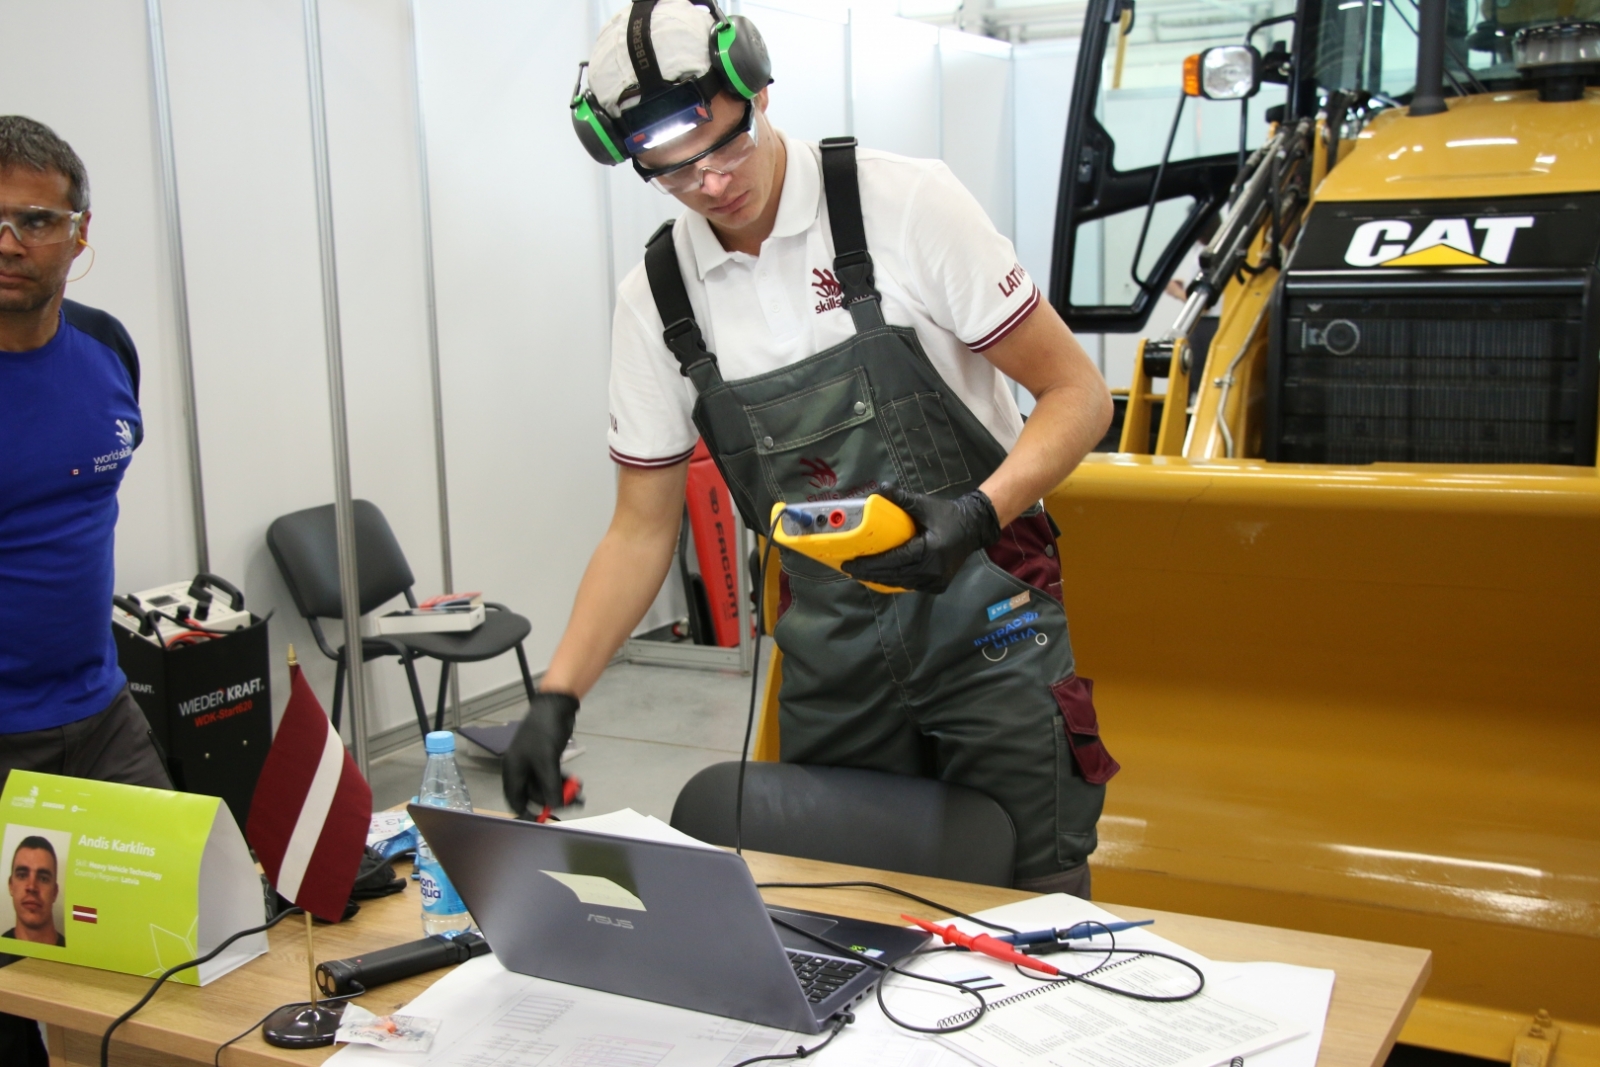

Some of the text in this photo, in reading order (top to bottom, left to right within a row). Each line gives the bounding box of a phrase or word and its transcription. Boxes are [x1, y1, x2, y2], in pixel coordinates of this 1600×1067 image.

[1344, 216, 1535, 267] CAT
[94, 462, 118, 473] France
[179, 690, 224, 716] WIEDER
[78, 834, 156, 857] Andis Karklins
[587, 913, 634, 930] ASUS
